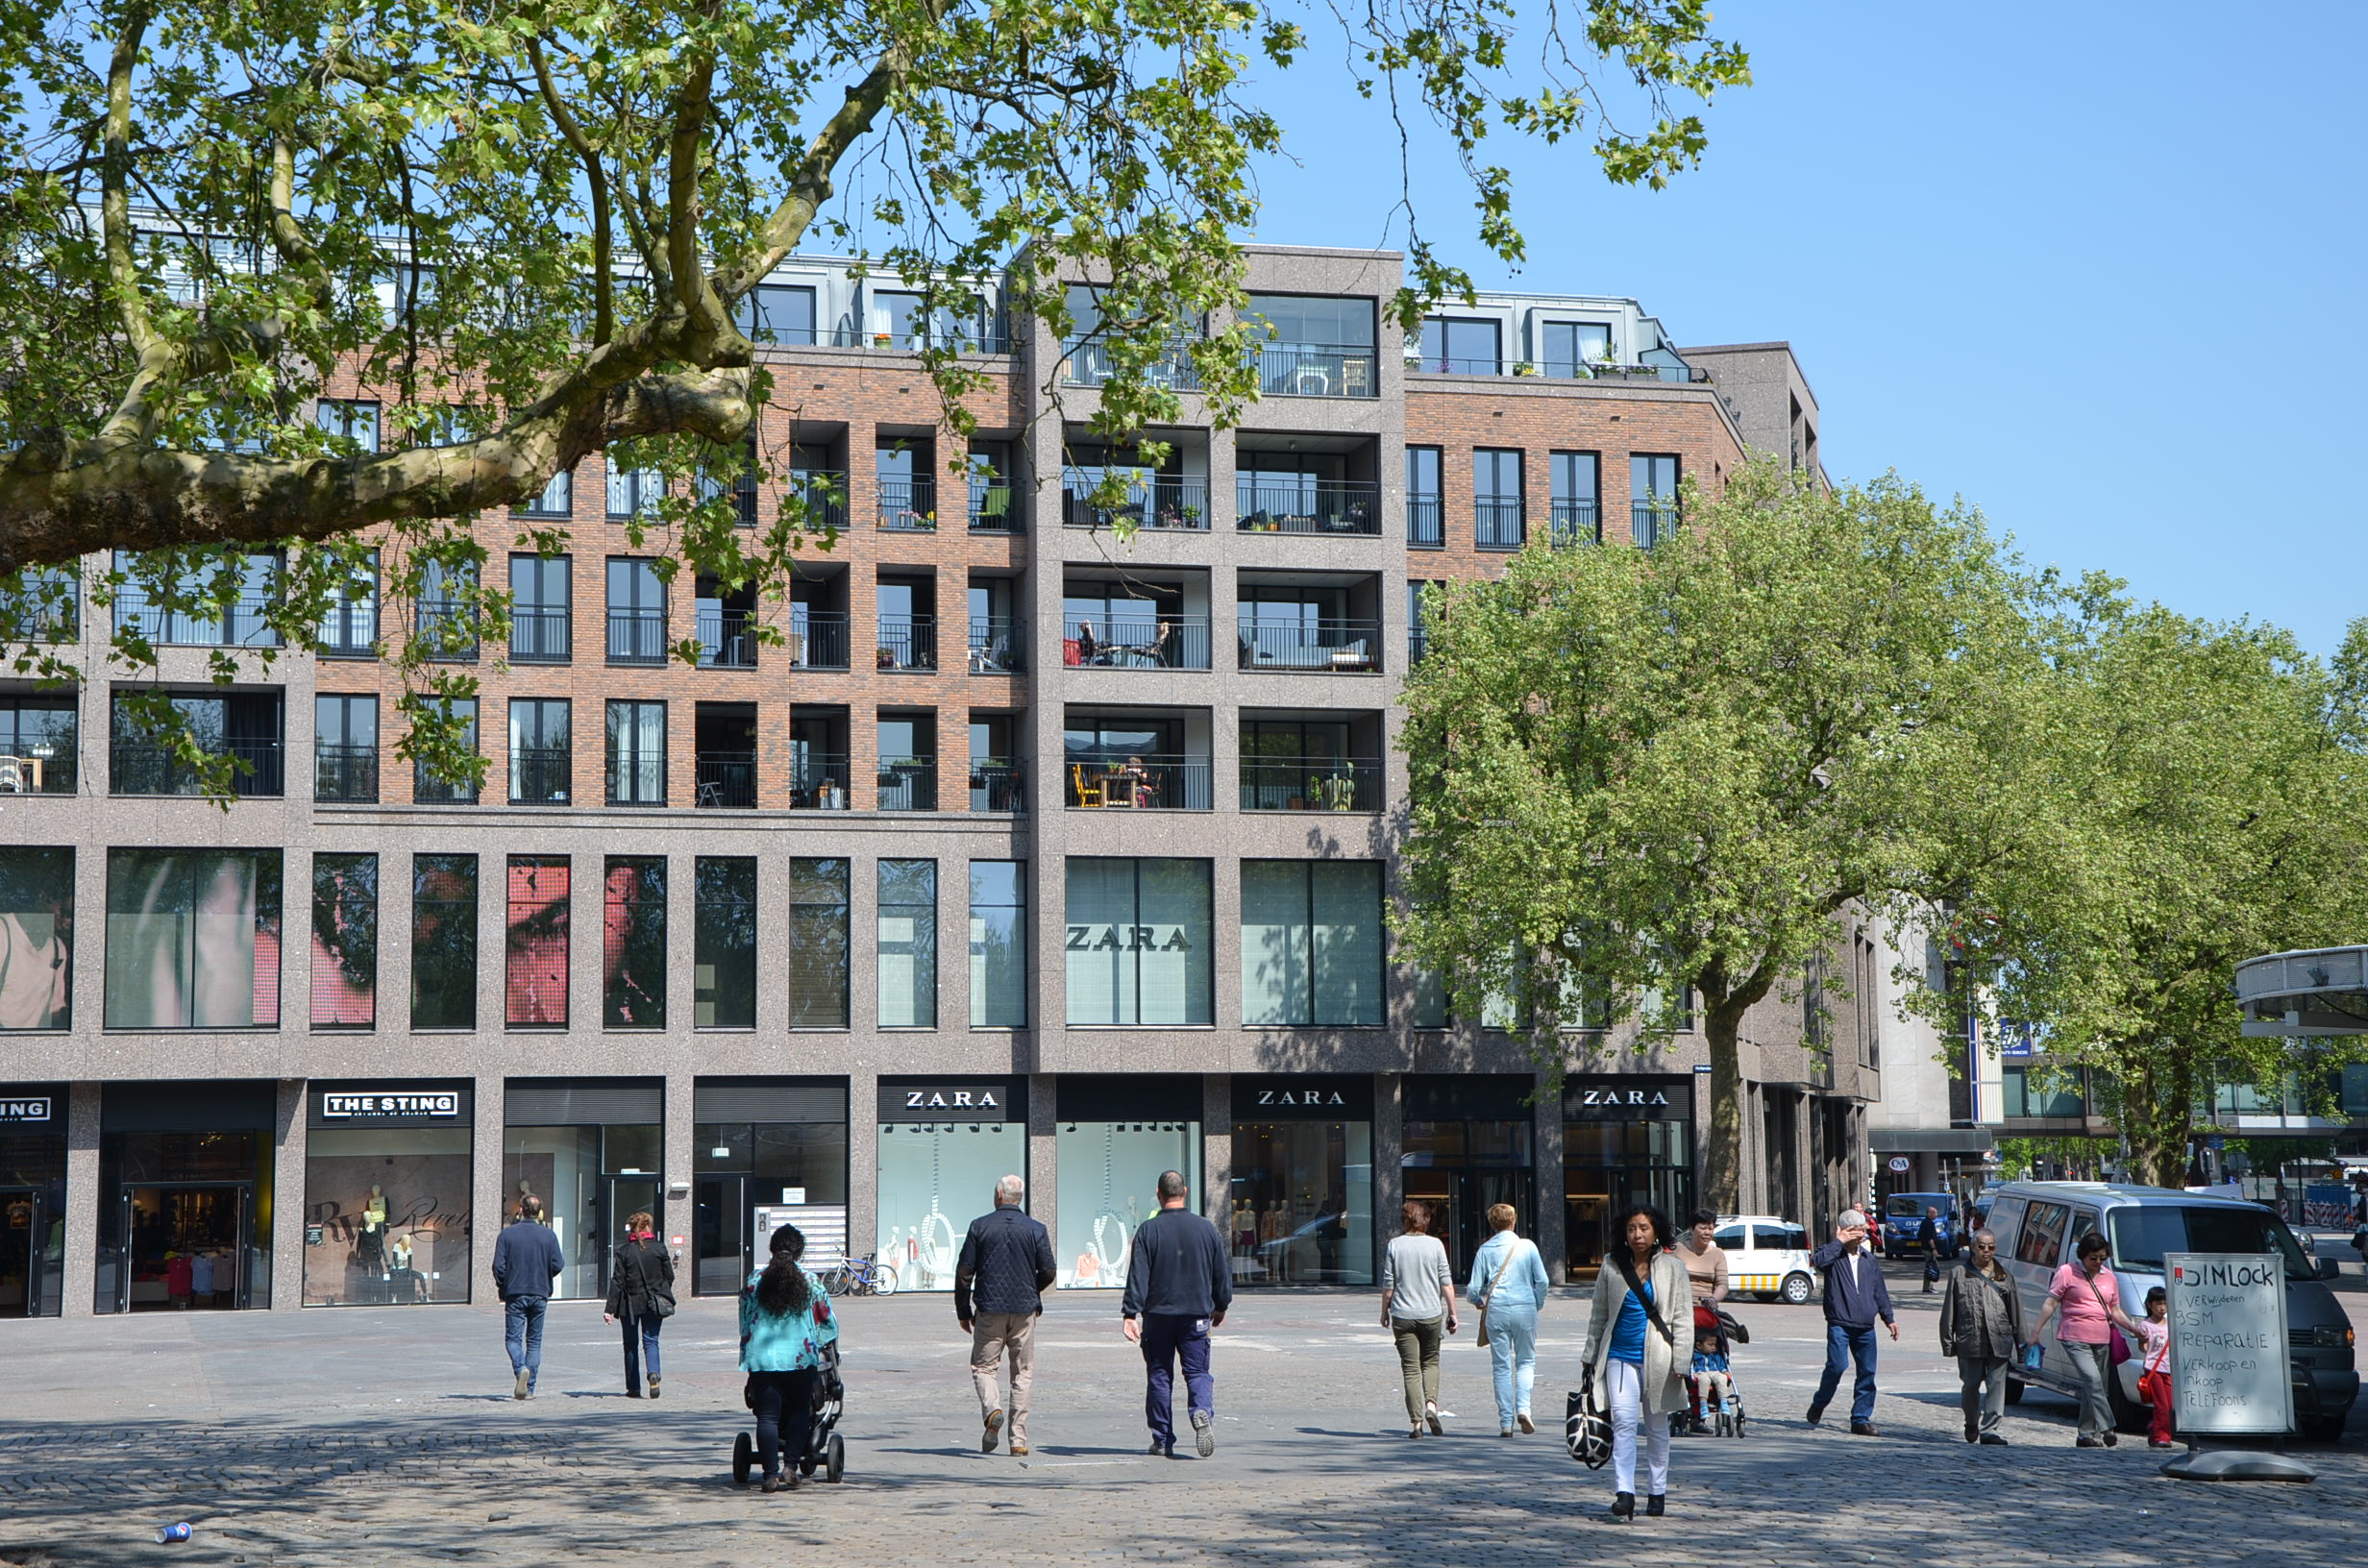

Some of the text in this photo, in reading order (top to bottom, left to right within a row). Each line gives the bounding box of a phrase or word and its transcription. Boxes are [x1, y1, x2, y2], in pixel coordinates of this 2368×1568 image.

[1066, 926, 1192, 952] ZARA
[330, 1097, 452, 1111] THE STING
[906, 1091, 999, 1107] ZARA
[1258, 1090, 1346, 1105] ZARA
[1583, 1090, 1669, 1105] ZARA
